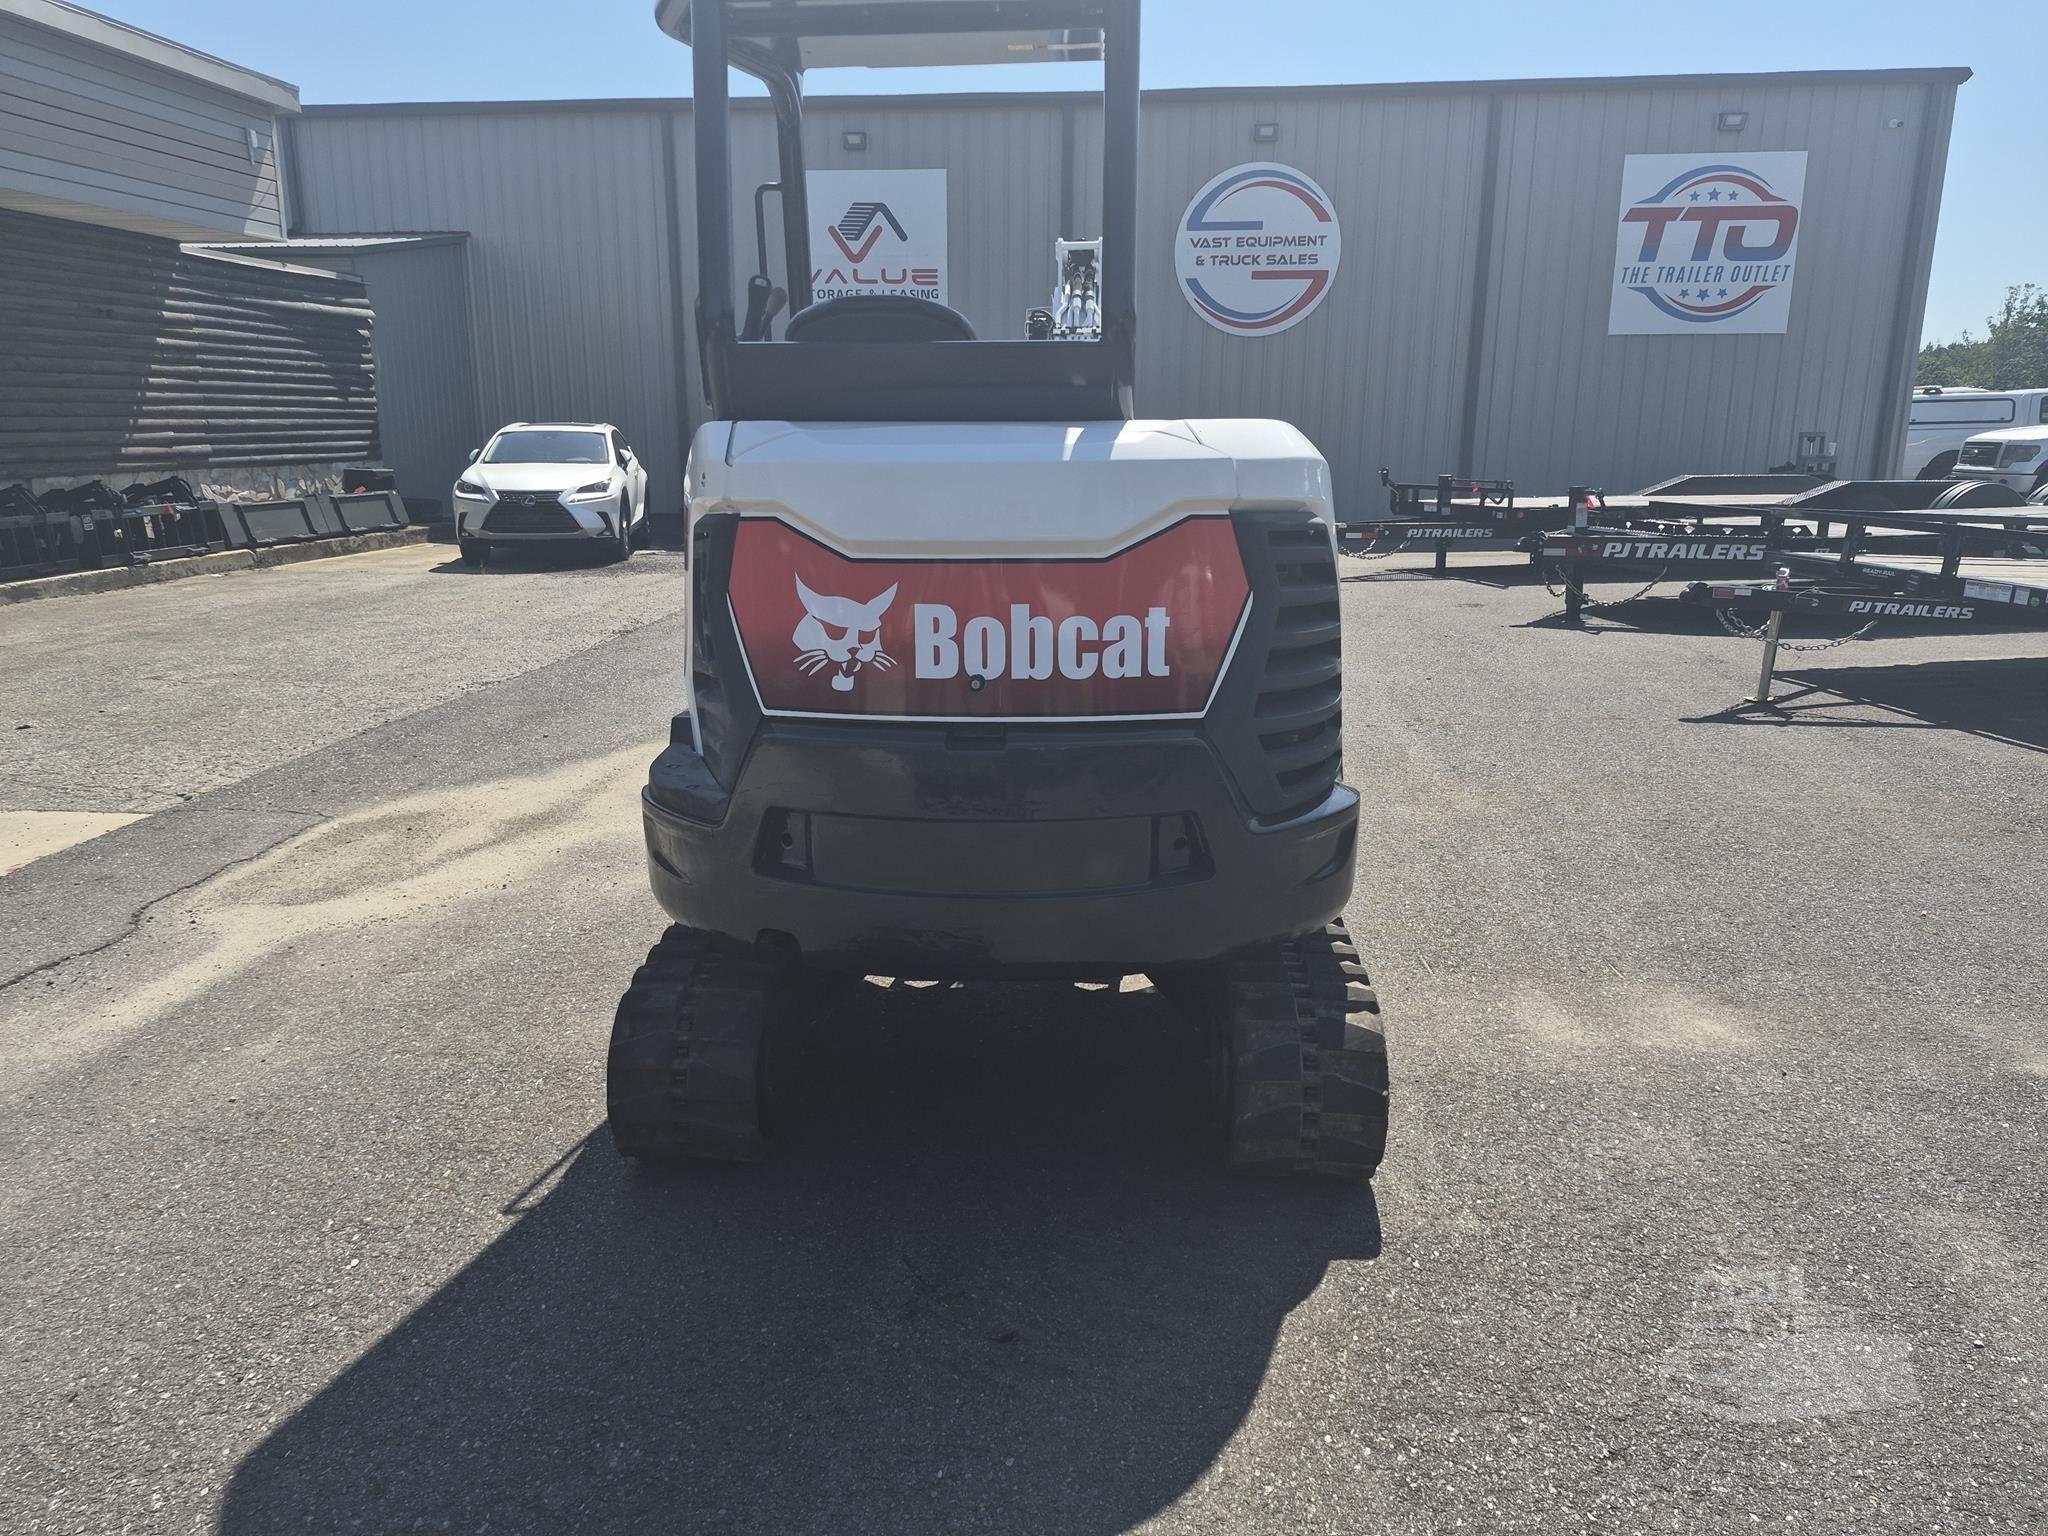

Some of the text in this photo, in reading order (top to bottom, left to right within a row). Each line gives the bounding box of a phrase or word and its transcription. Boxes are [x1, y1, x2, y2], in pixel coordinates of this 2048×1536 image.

[1190, 235, 1327, 248] VAST EQUIPMENT
[1195, 253, 1318, 266] & TRUCK SALES
[1621, 264, 1791, 284] THE TRAILER OUTLET
[914, 603, 1170, 681] Bobcat
